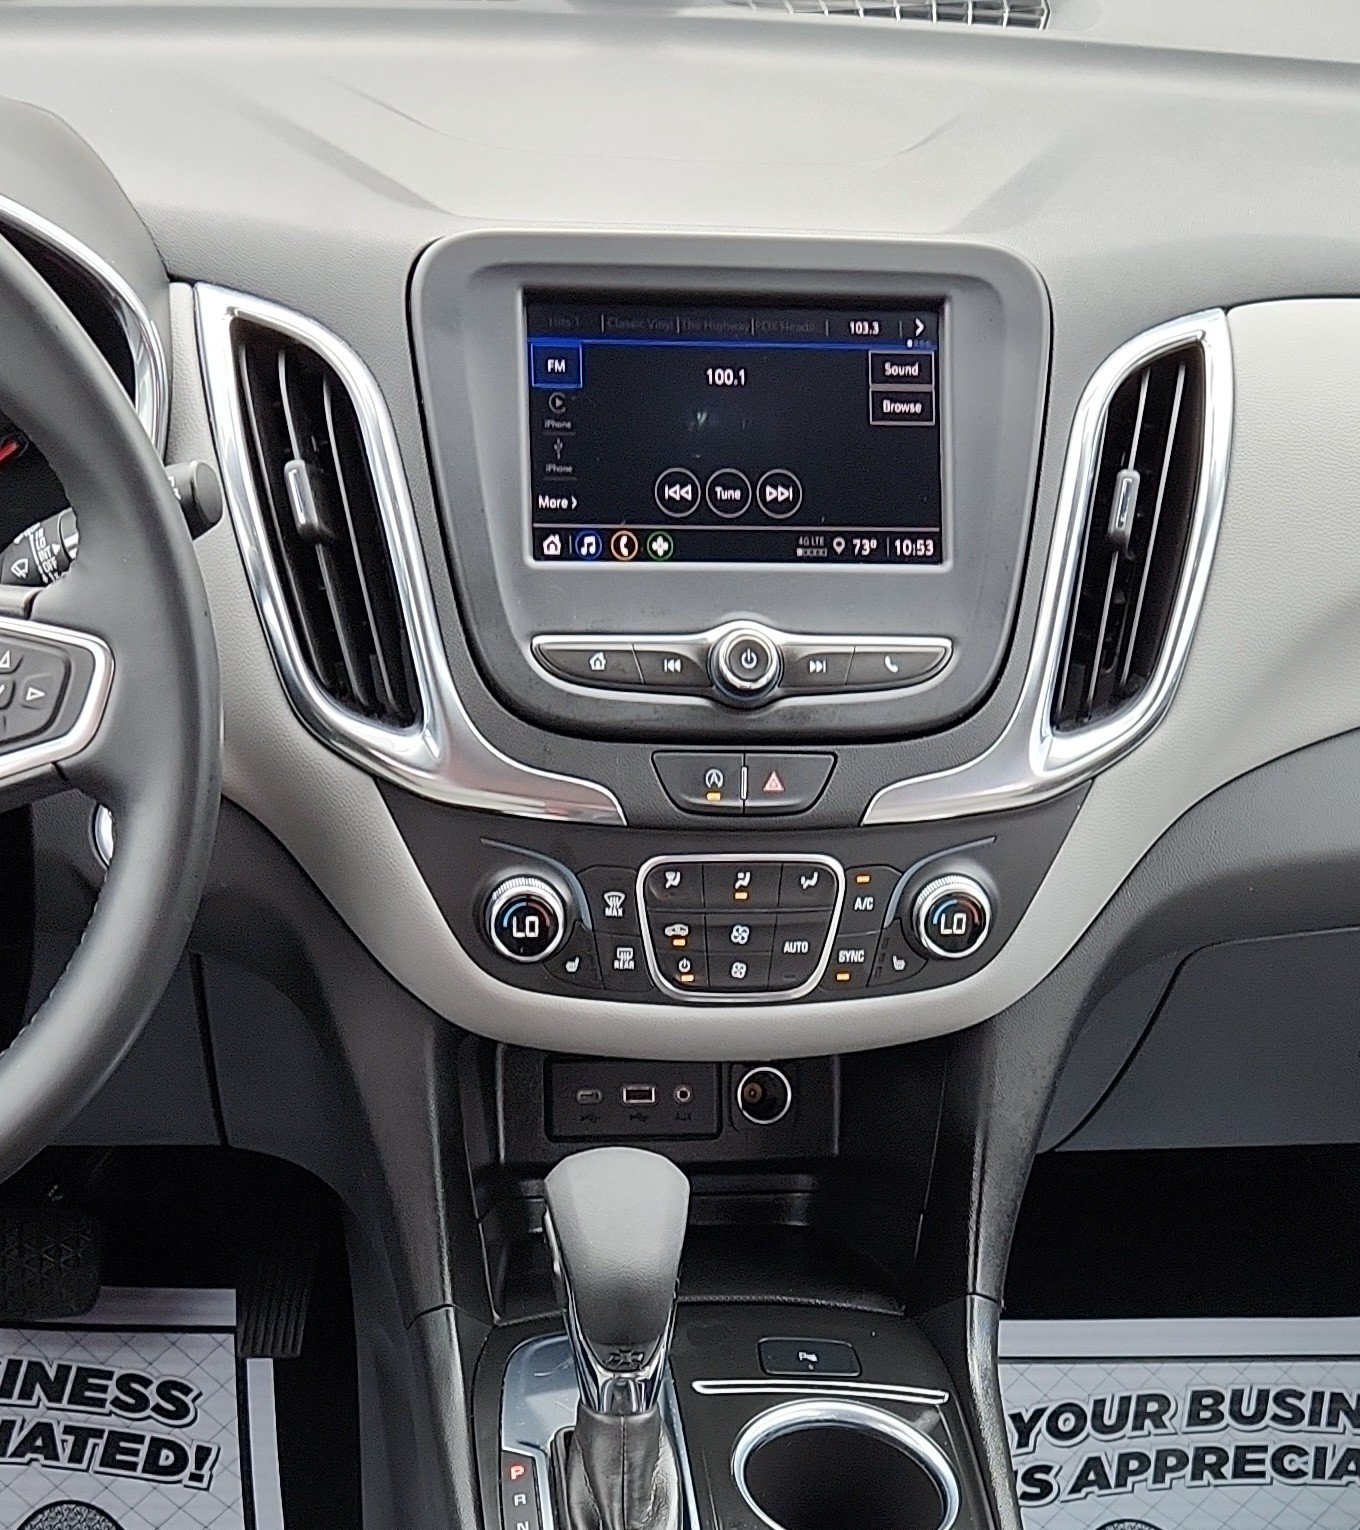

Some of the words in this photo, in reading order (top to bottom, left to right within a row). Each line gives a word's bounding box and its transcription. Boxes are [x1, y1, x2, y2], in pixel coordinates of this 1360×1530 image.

[849, 320, 880, 336] 103.3
[547, 359, 566, 373] FM
[885, 362, 918, 377] Sound
[706, 368, 746, 386] 100.1
[883, 400, 922, 414] Browse
[715, 487, 741, 501] Tune
[539, 495, 568, 510] More
[895, 539, 934, 556] 10:53
[604, 903, 623, 918] MAX
[854, 897, 874, 912] A/C
[512, 917, 539, 939] LO
[940, 914, 966, 934] LO
[783, 940, 808, 954] AUTO
[614, 959, 634, 970] REAR
[838, 949, 864, 965] SYNC
[1009, 1391, 1177, 1455] YOUR
[510, 1465, 524, 1480] P
[1014, 1462, 1060, 1505] S
[514, 1494, 526, 1506] R
